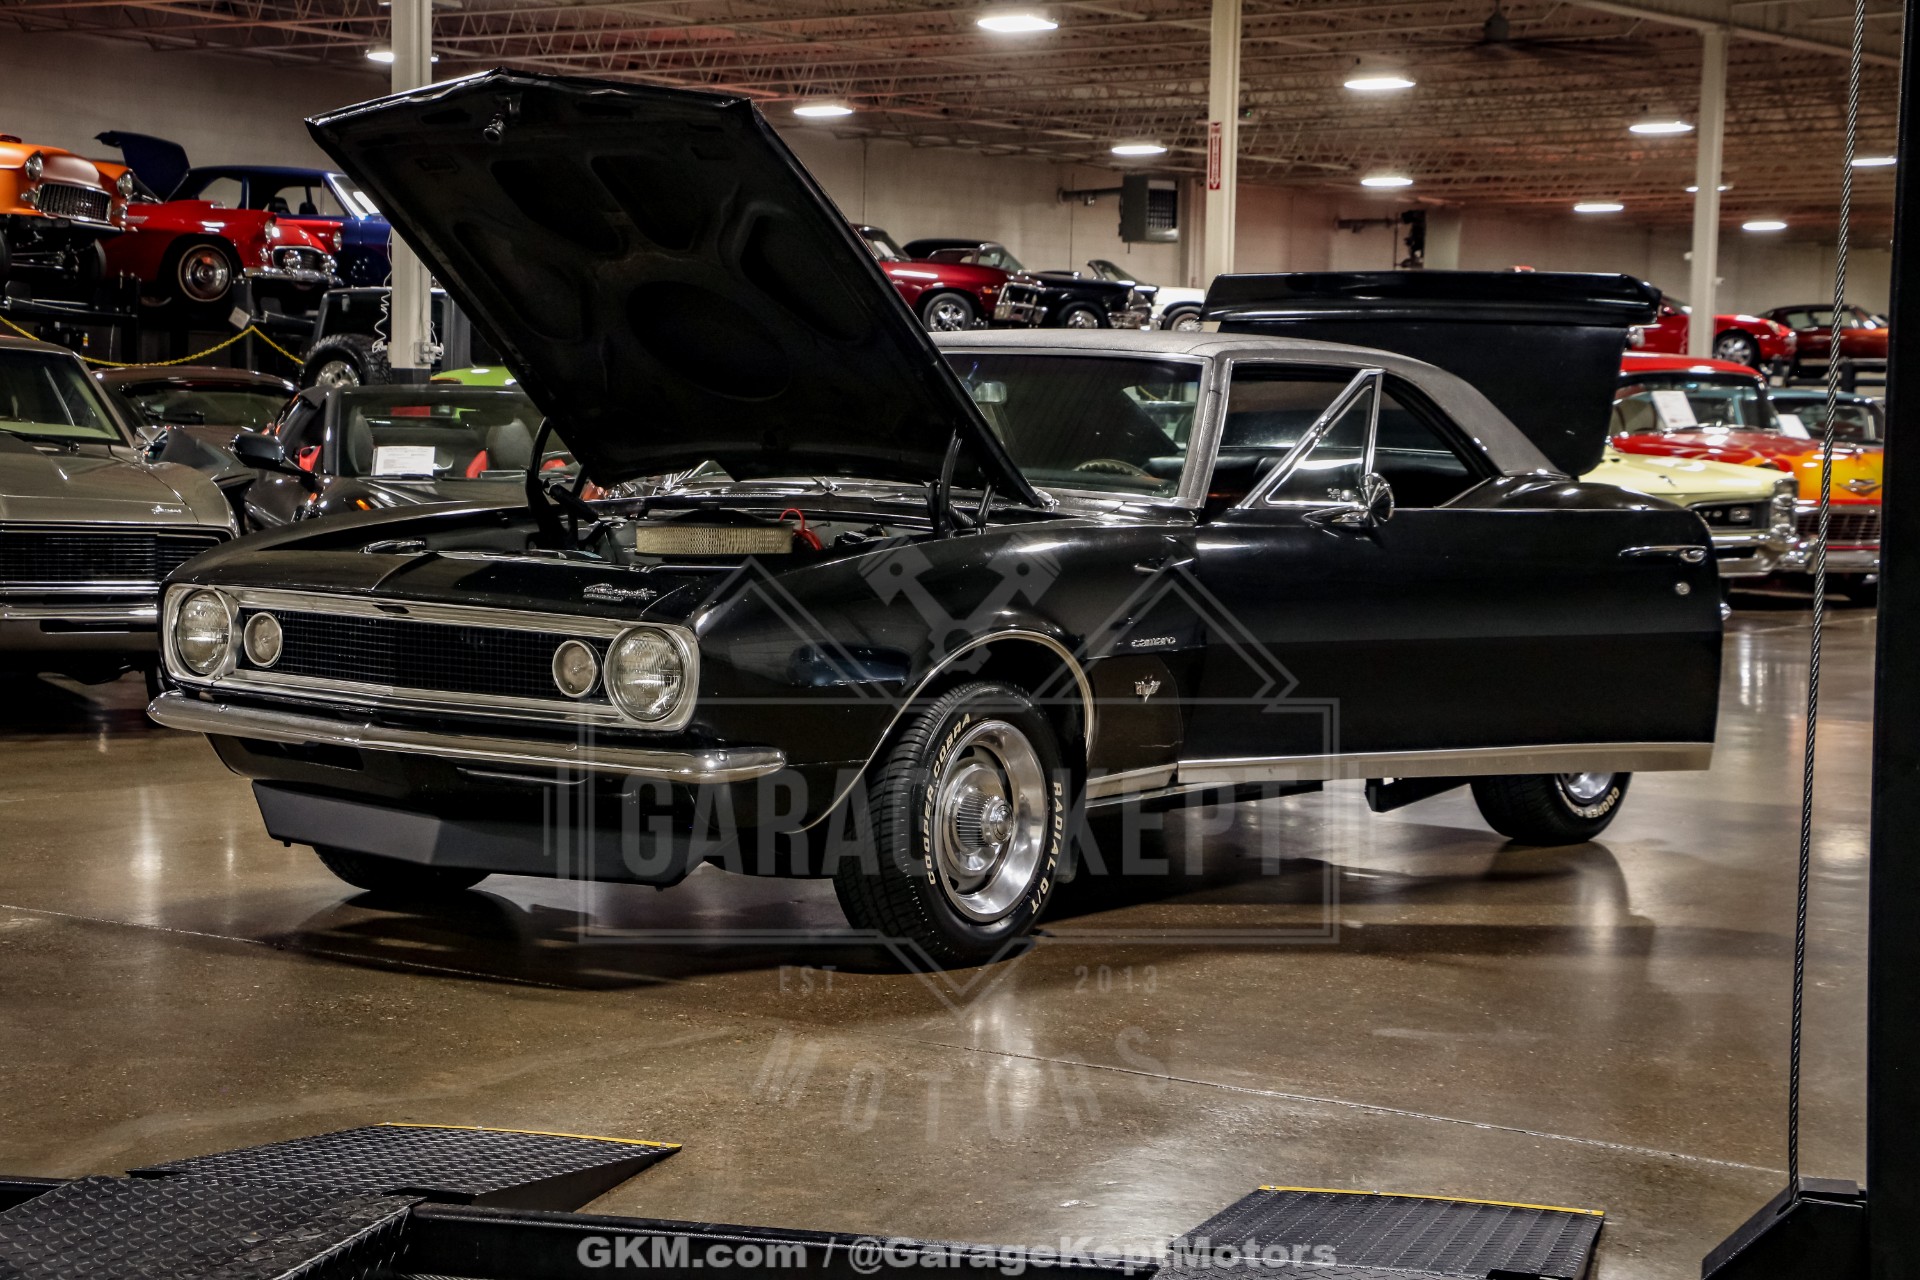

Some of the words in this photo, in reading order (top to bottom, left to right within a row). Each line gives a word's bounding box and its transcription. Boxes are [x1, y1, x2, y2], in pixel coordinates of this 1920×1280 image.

[923, 785, 936, 885] COOPER
[933, 713, 972, 779] COBRA
[1046, 782, 1064, 871] RADIAL
